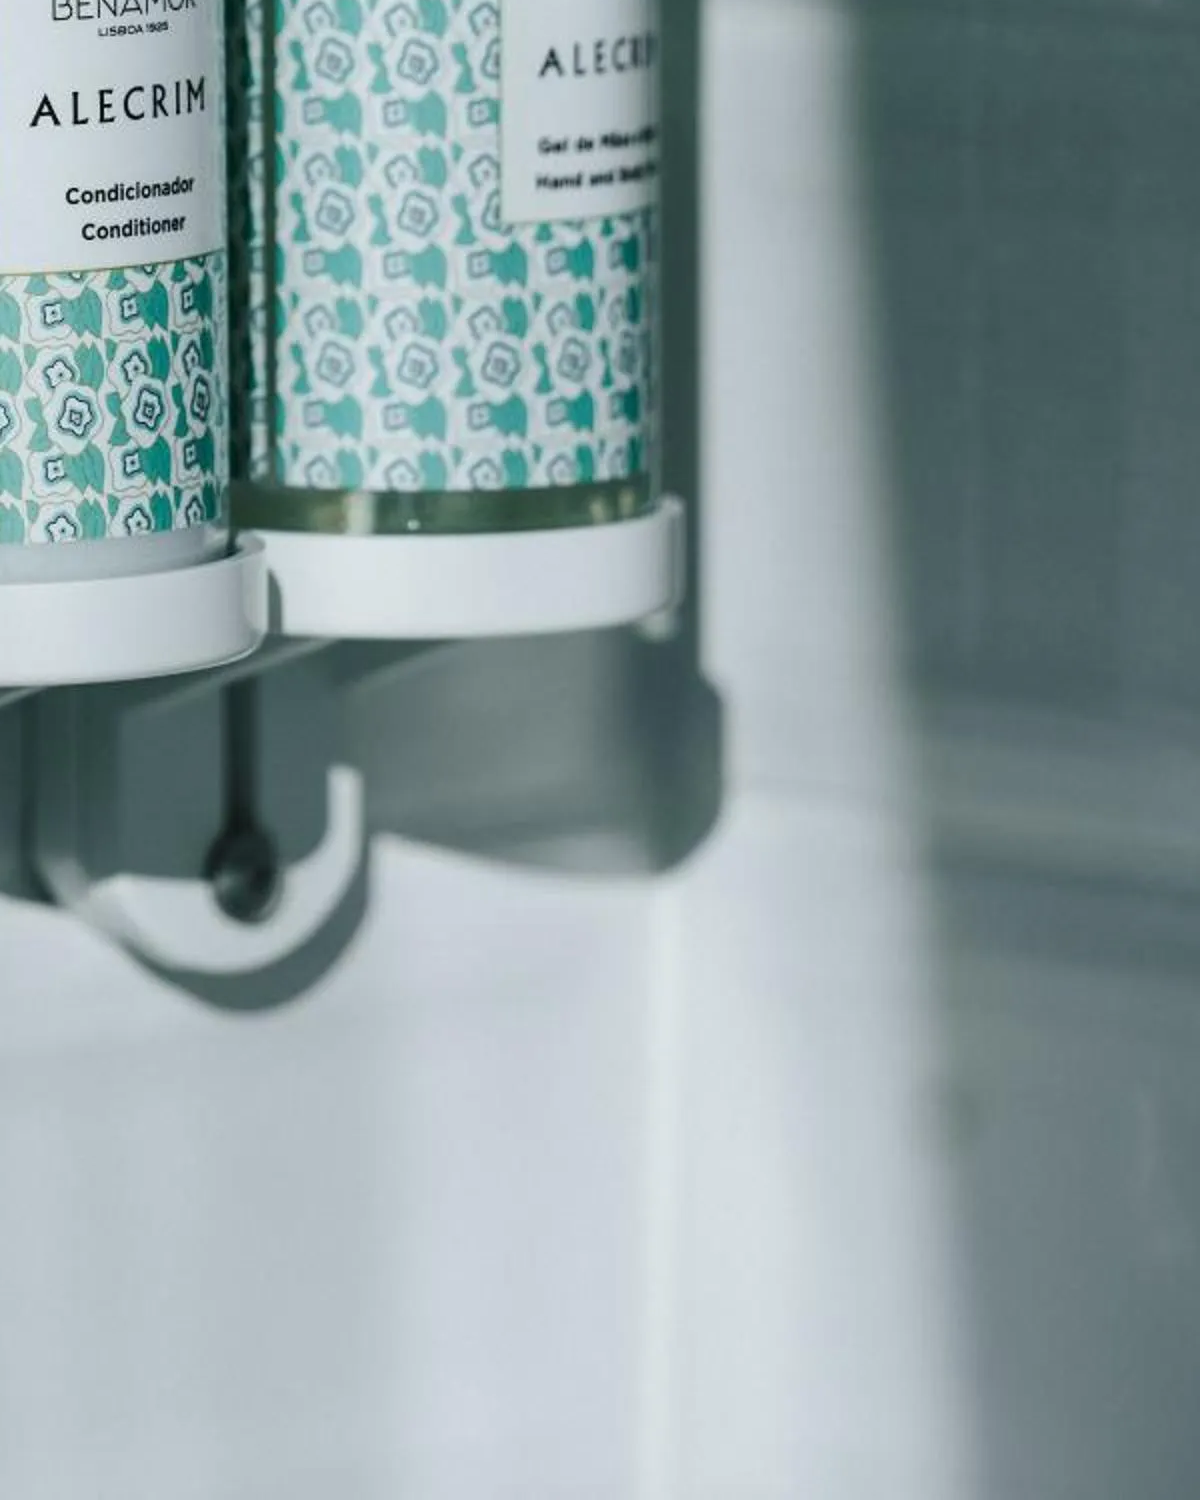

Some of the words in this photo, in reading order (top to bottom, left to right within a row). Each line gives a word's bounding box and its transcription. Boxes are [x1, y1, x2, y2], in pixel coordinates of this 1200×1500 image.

[97, 24, 143, 37] LISBOA
[30, 76, 206, 127] ALECRIM
[65, 176, 196, 205] Condicionador
[81, 214, 186, 241] Conditioner
